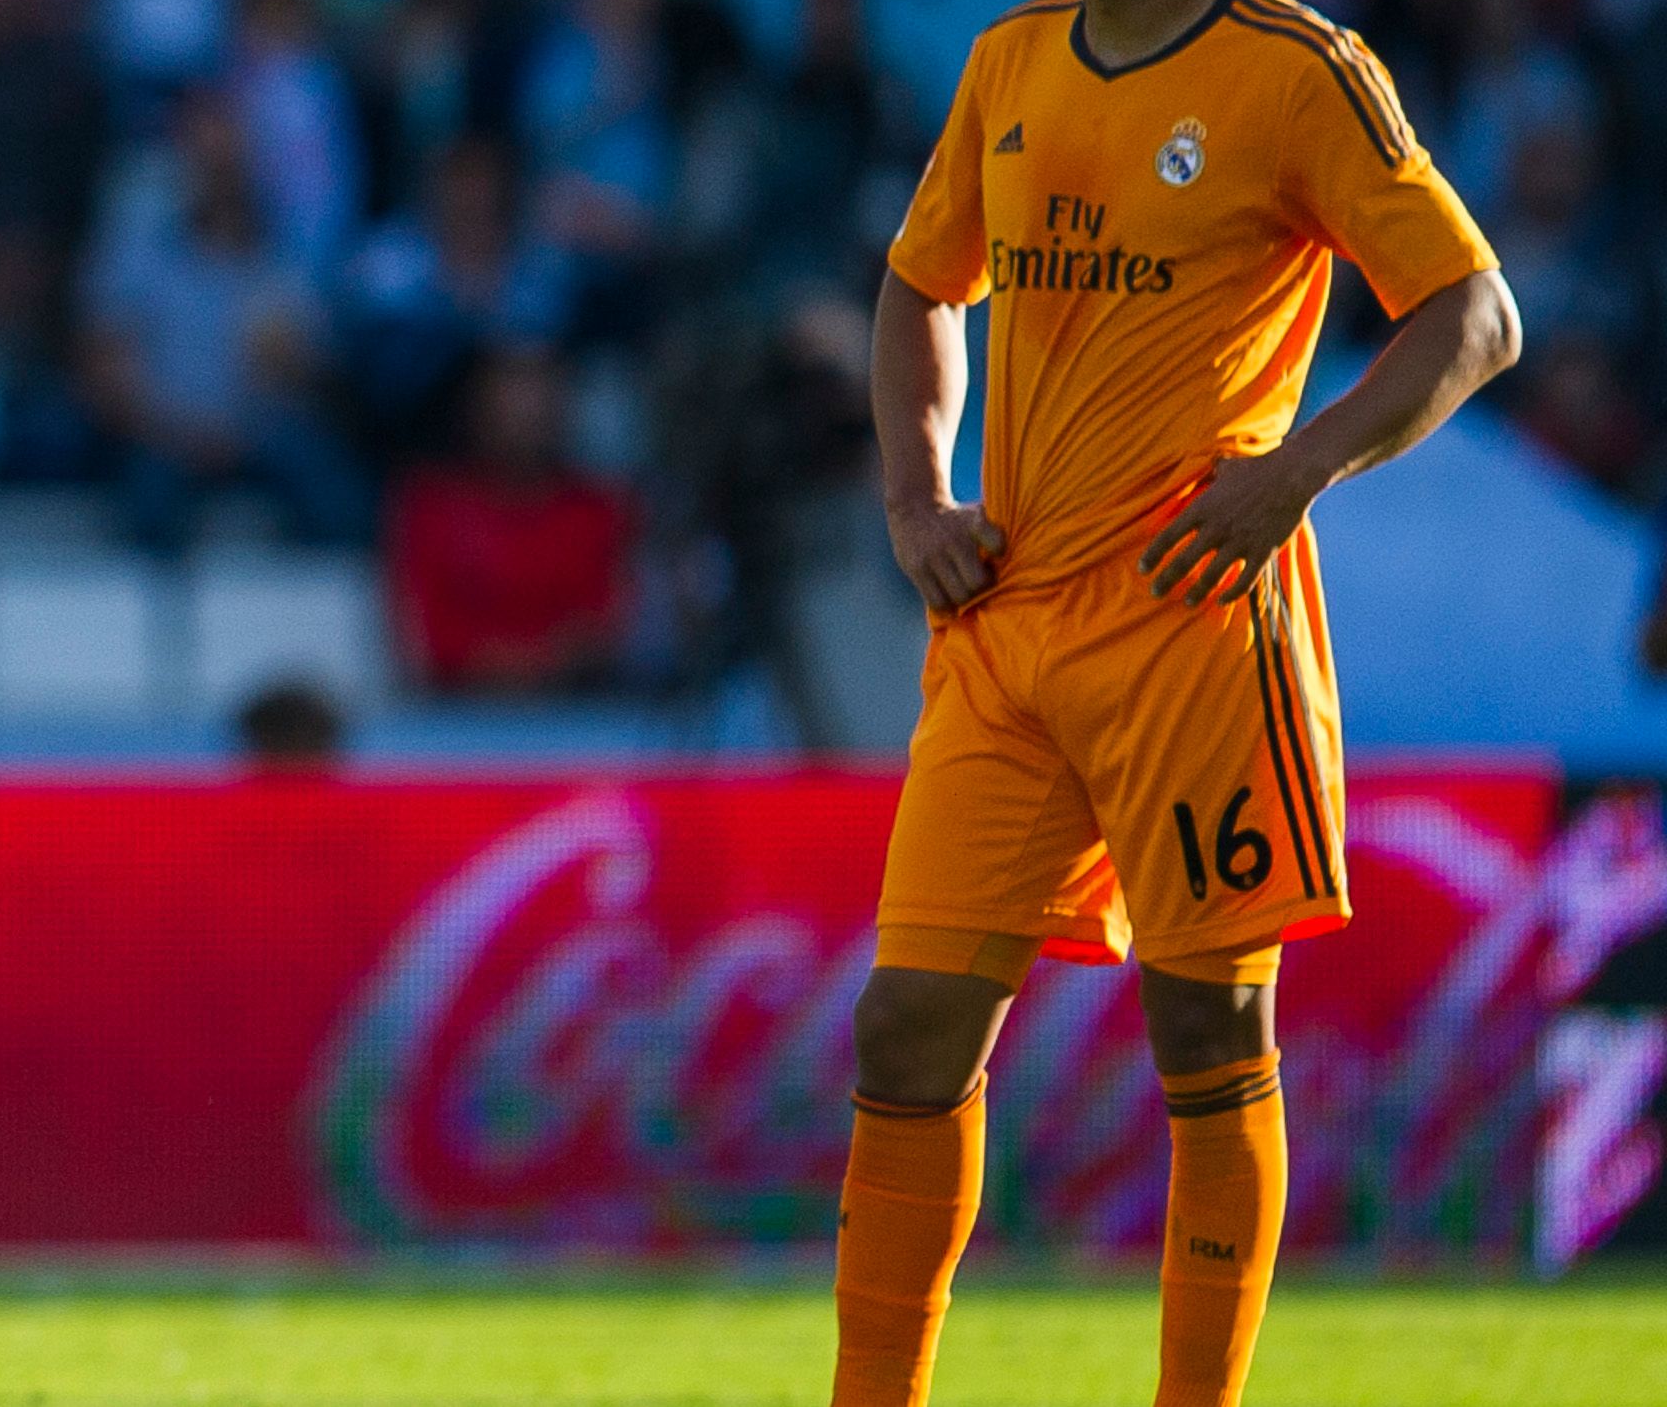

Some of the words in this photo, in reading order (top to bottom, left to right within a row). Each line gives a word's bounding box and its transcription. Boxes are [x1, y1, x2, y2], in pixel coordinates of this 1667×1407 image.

[1046, 194, 1105, 240] Fly
[992, 235, 1177, 294] Emirates
[1173, 785, 1273, 902] 16
